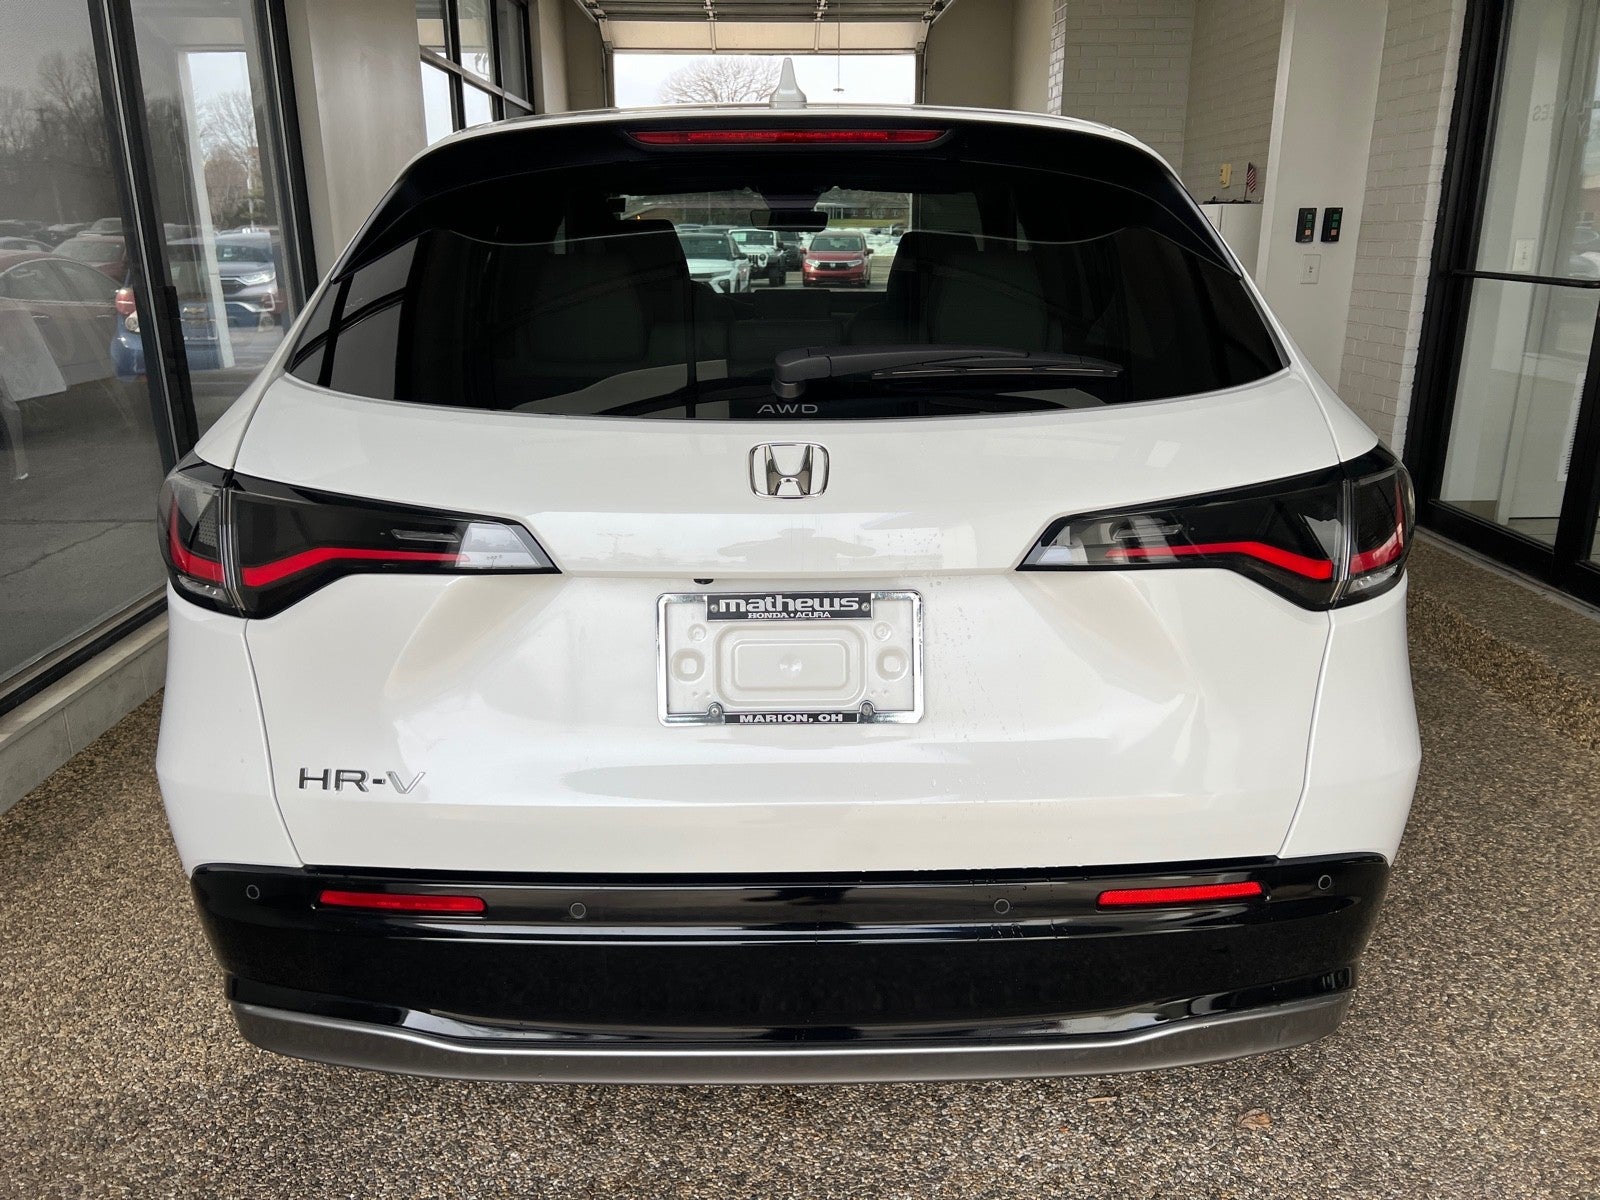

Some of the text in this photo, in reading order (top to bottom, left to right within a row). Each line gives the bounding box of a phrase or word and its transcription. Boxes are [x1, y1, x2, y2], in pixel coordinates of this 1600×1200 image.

[757, 403, 818, 414] AWD
[719, 595, 859, 612] mathews
[748, 611, 789, 619] HONDA
[740, 714, 843, 723] MARION, OH
[299, 767, 426, 794] HR-V
